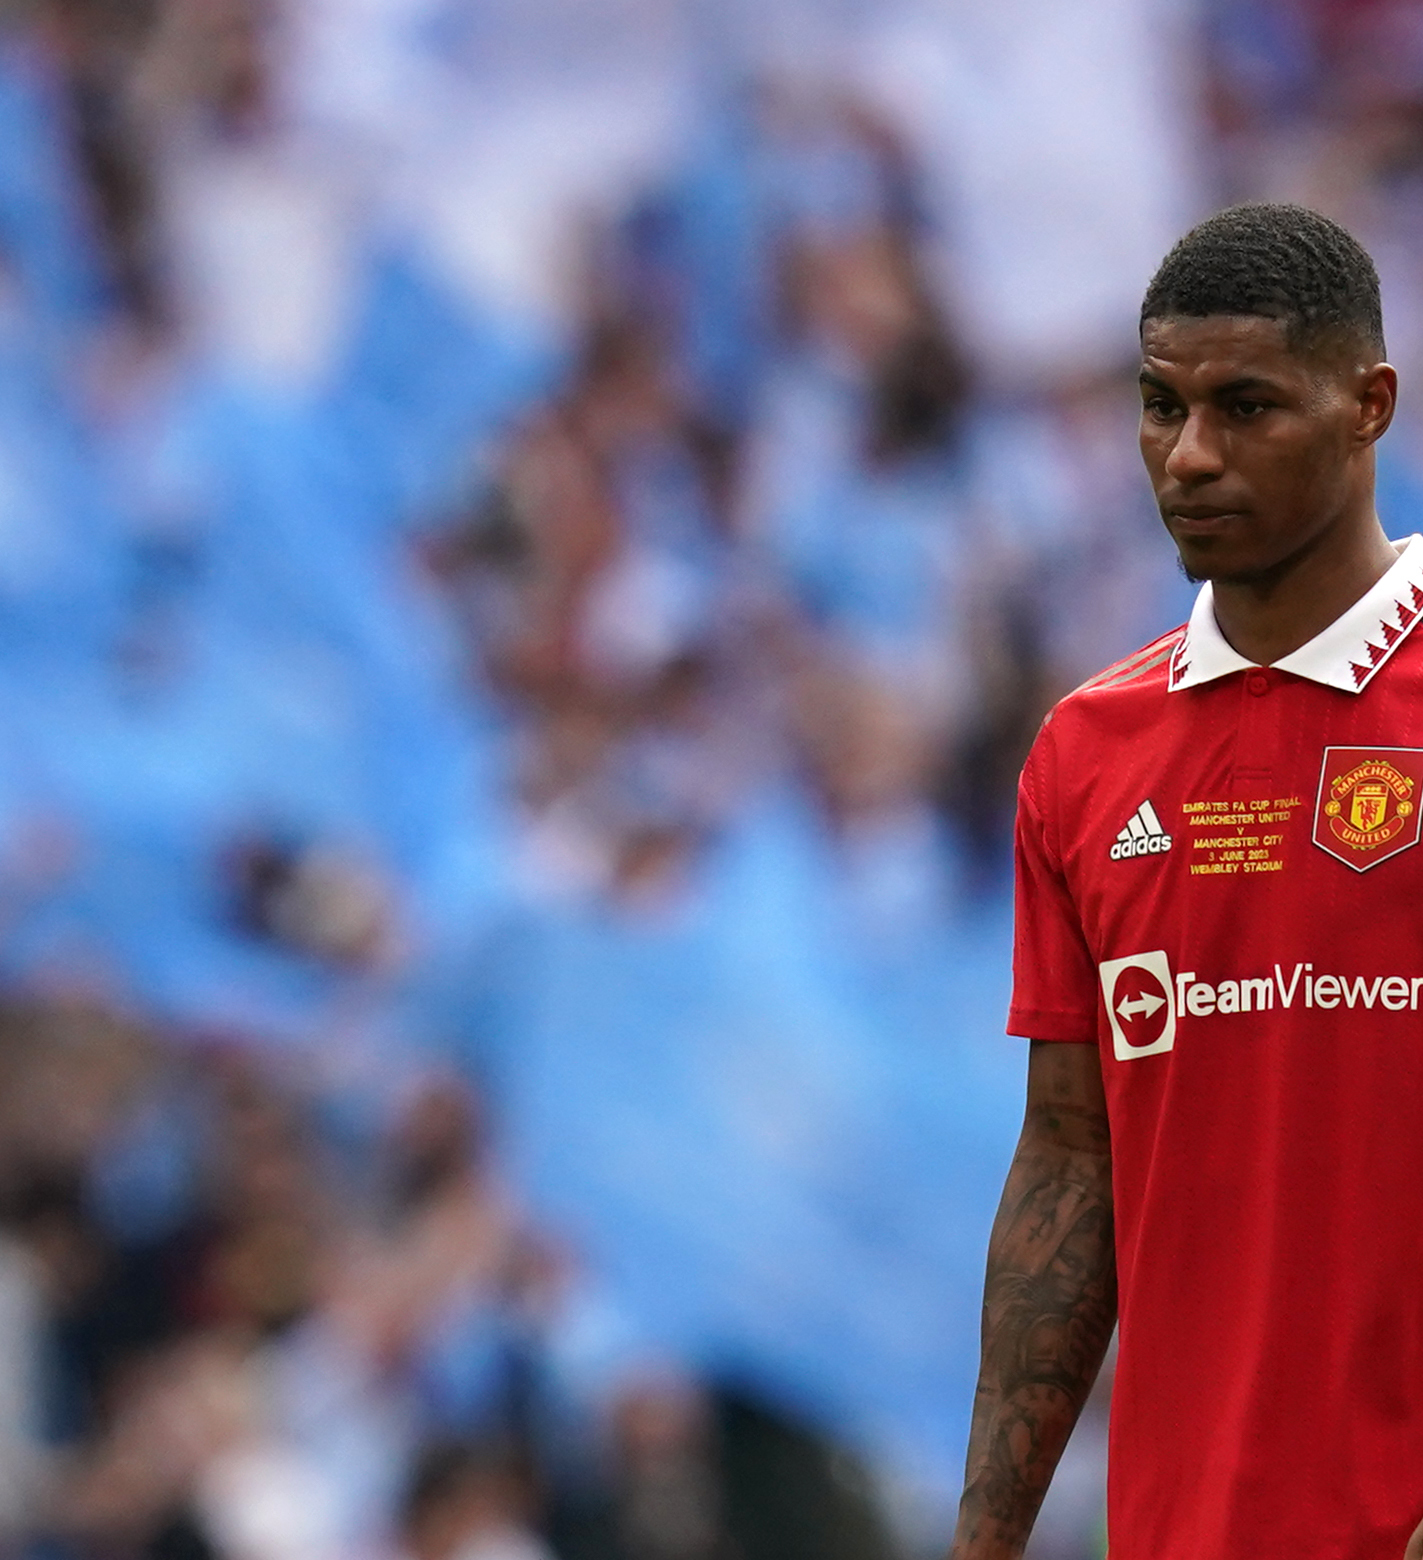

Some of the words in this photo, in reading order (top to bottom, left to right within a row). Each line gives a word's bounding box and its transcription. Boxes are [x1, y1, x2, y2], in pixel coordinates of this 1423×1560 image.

[1337, 766, 1407, 795] MANCHESTER
[1182, 801, 1229, 813] EMIRATES
[1232, 801, 1246, 812] FA
[1249, 800, 1270, 811] CUP
[1273, 796, 1301, 809] FINAL
[1189, 813, 1254, 825] MANCHESTER
[1258, 811, 1291, 823] UNITED
[1193, 836, 1259, 849] MANCHESTER
[1262, 834, 1283, 846] CITY
[1341, 827, 1391, 844] UNITED
[1110, 834, 1172, 861] adidas
[1208, 851, 1215, 861] 3
[1219, 850, 1245, 862] JUNE
[1248, 849, 1269, 860] 2023
[1190, 863, 1239, 875] WEMBLEY
[1243, 860, 1283, 873] STADIUM
